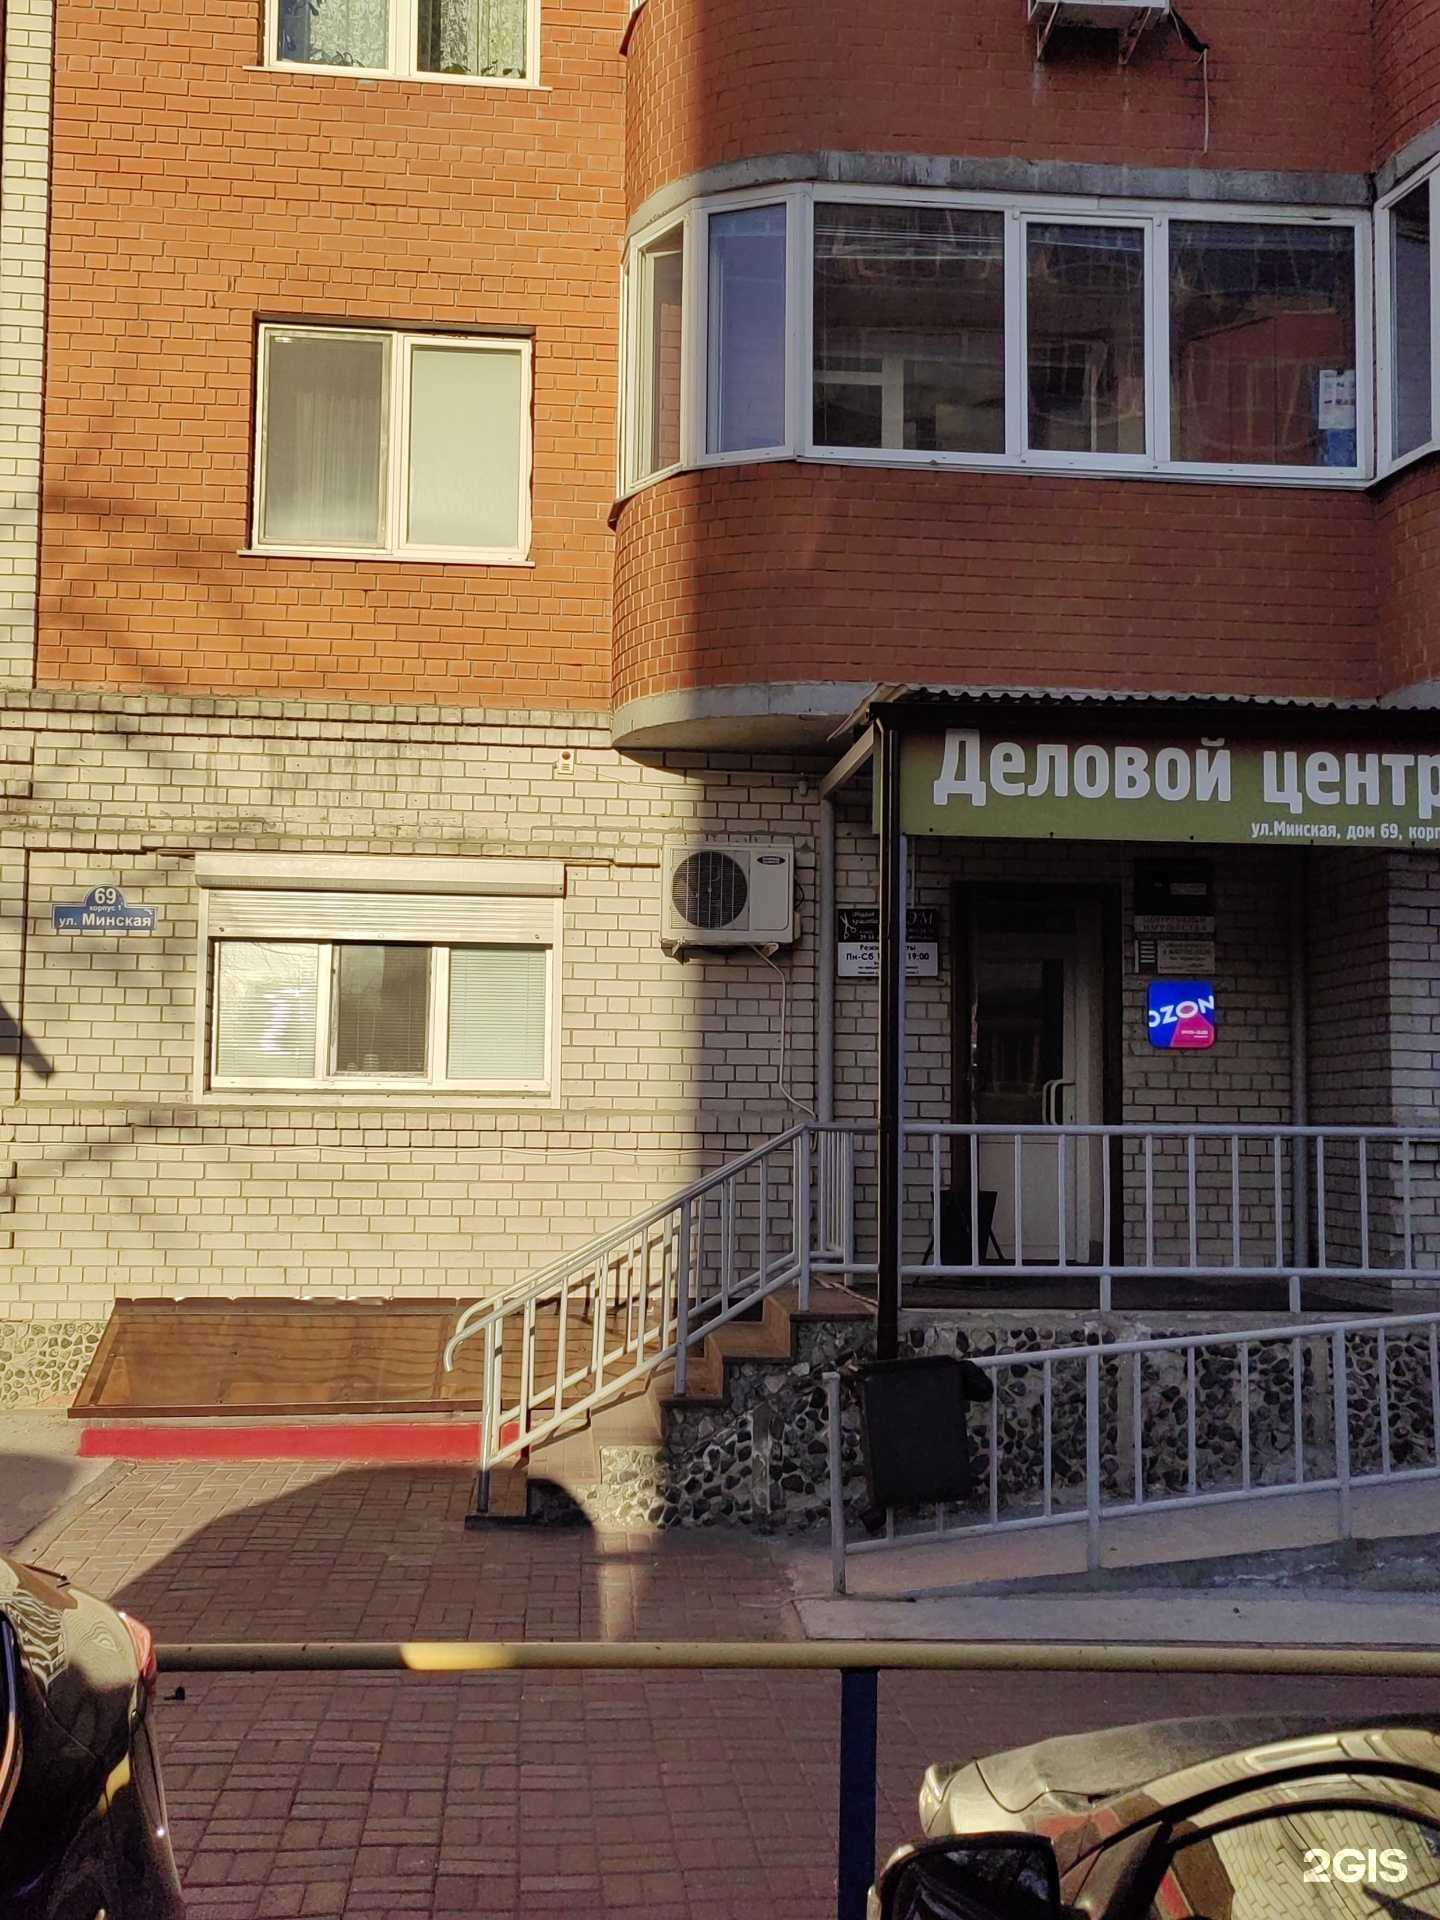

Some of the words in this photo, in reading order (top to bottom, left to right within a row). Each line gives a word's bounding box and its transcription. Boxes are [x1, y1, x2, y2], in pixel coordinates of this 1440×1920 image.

[933, 728, 1231, 806] Деловой
[1263, 750, 1440, 819] центр
[1346, 825, 1375, 840] дом
[1380, 823, 1402, 840] 69,
[94, 887, 117, 905] 69
[59, 917, 77, 928] ул.
[82, 913, 151, 926] Минская
